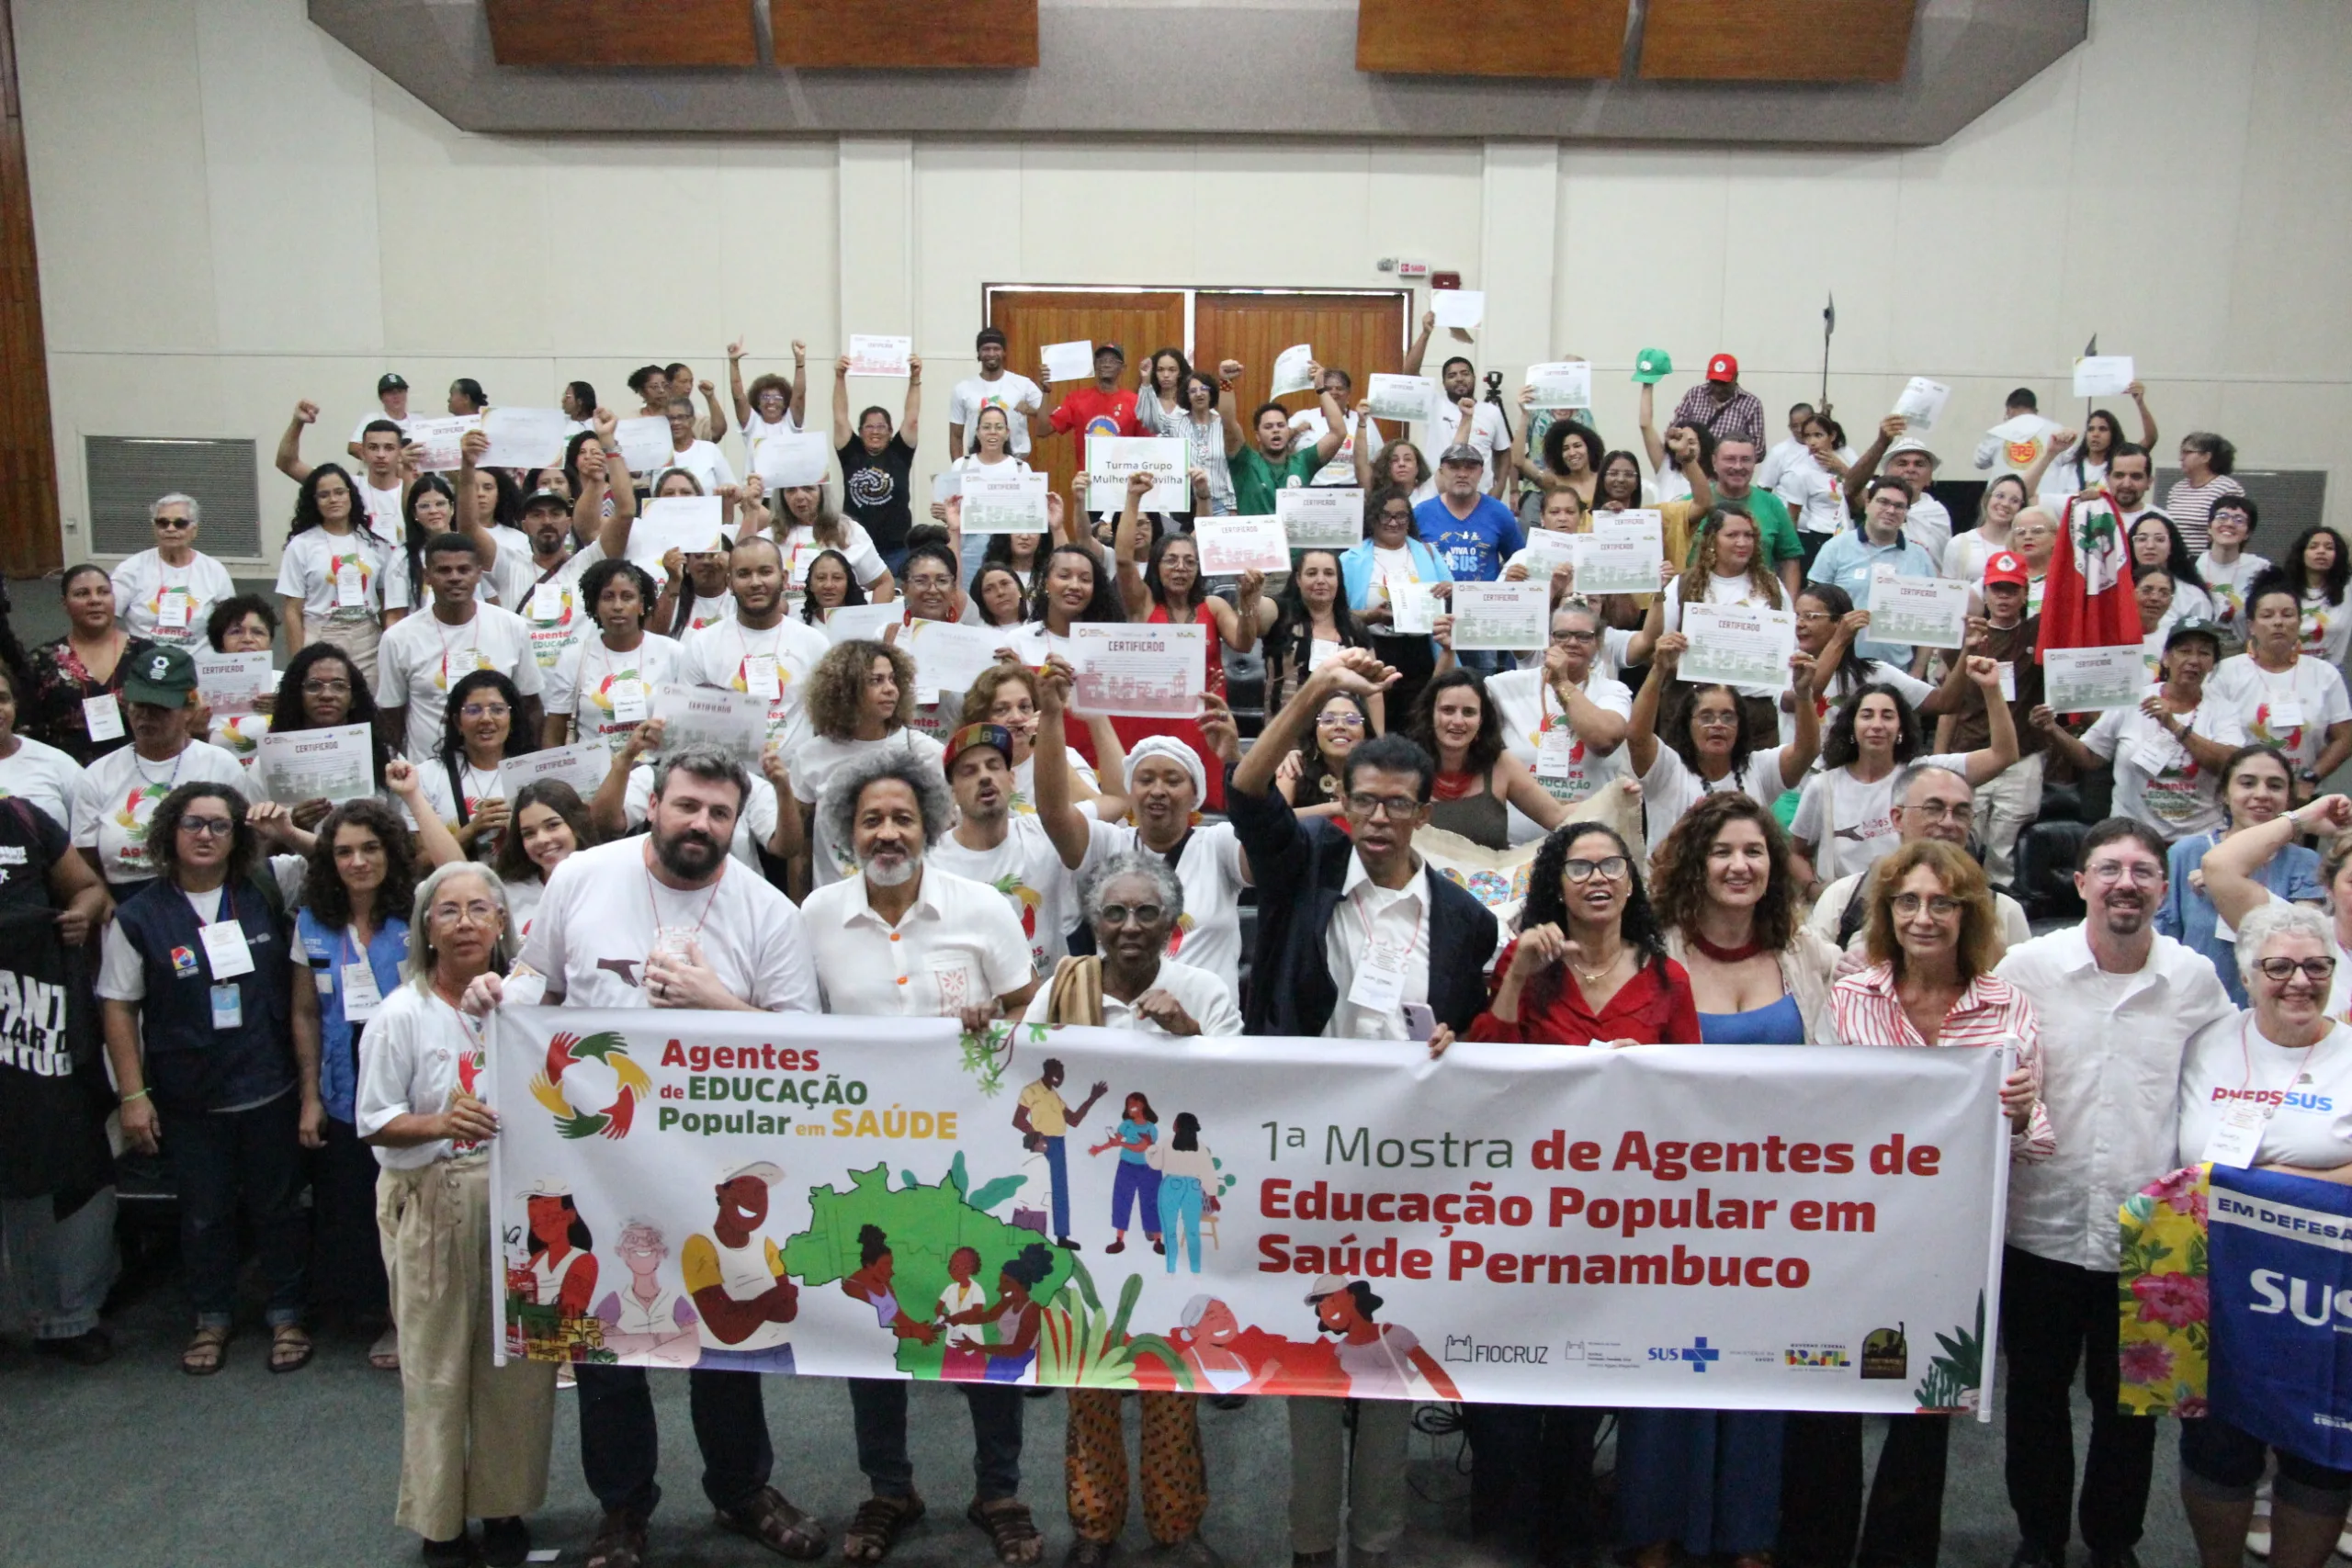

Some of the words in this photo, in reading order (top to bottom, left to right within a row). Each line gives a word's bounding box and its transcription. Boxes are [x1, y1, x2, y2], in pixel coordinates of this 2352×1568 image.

[1105, 461, 1138, 470] Turma
[1141, 461, 1172, 472] Grupo
[1450, 547, 1468, 556] VIVA
[1469, 547, 1476, 556] O
[1450, 556, 1478, 572] SUS
[1483, 593, 1519, 602] CERTIFICADO
[1900, 587, 1937, 598] CERTIFICADO
[1718, 619, 1760, 632] CERTIFICADO
[1108, 640, 1165, 652] CERTIFICADO
[202, 664, 244, 674] CERTIFICADO
[2075, 659, 2111, 668] CERTIFICADO
[296, 741, 339, 753] CERTIFICADO
[535, 757, 577, 773] CERTIFICADO
[661, 1039, 820, 1073] Agentes
[661, 1085, 684, 1100] de
[689, 1074, 867, 1110] EDUCAÇÃO
[660, 1108, 791, 1136] Popular
[796, 1125, 826, 1136] em
[832, 1102, 957, 1140] SAÚDE
[1261, 1122, 1306, 1162] 1ª
[1326, 1125, 1513, 1168] Mostra
[1532, 1130, 1601, 1172] de
[1613, 1131, 1854, 1181] Agentes
[1871, 1134, 1940, 1177] de
[1260, 1179, 1532, 1237] Educação
[1549, 1187, 1778, 1237] Popular
[1791, 1201, 1876, 1233] em
[2218, 1197, 2255, 1218] EM
[1258, 1234, 1433, 1279] Saúde
[1449, 1240, 1810, 1289] Pernambuco
[1476, 1346, 1548, 1364] FIOCRUZ
[1647, 1348, 1679, 1361] SUS
[1785, 1349, 1850, 1366] BRASIL
